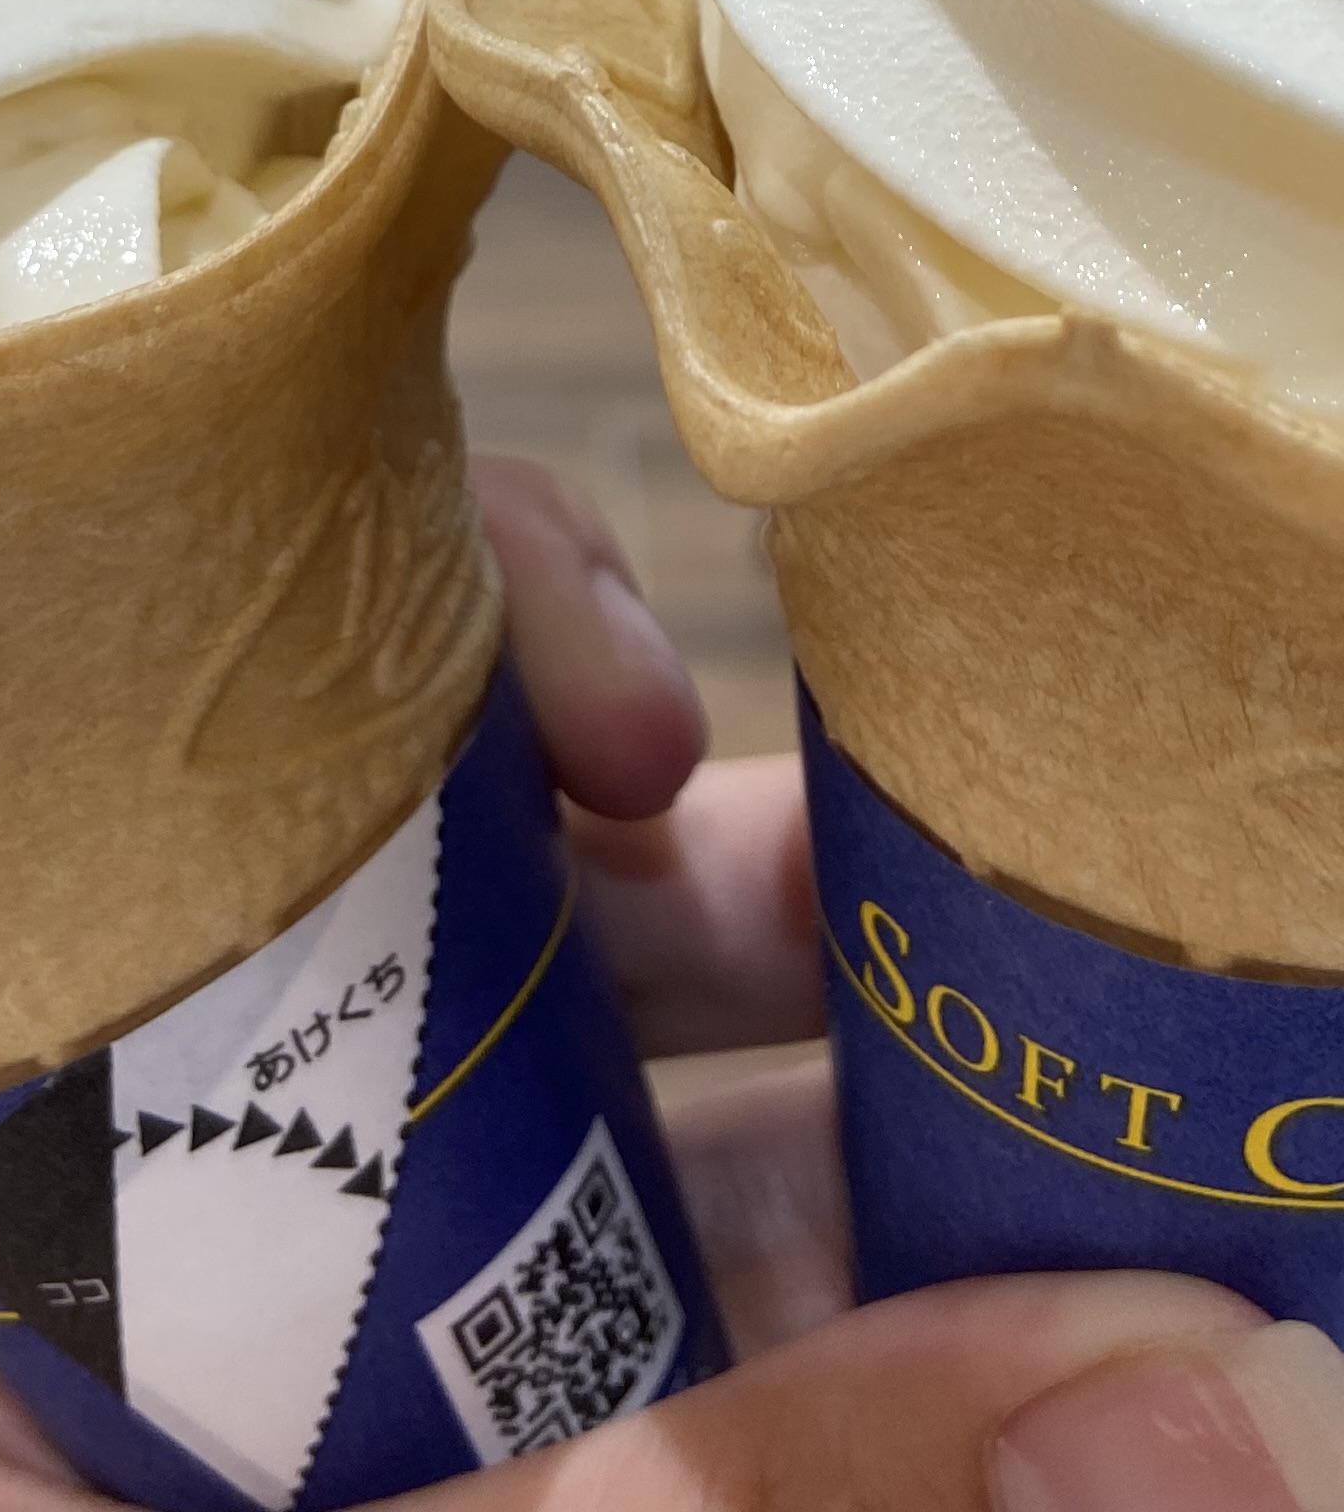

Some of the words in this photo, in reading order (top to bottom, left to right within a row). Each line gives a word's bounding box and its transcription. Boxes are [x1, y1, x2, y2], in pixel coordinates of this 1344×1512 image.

[244, 951, 406, 1092] あけくち
[860, 899, 1183, 1152] SOFT
[37, 1277, 111, 1306] ココ
